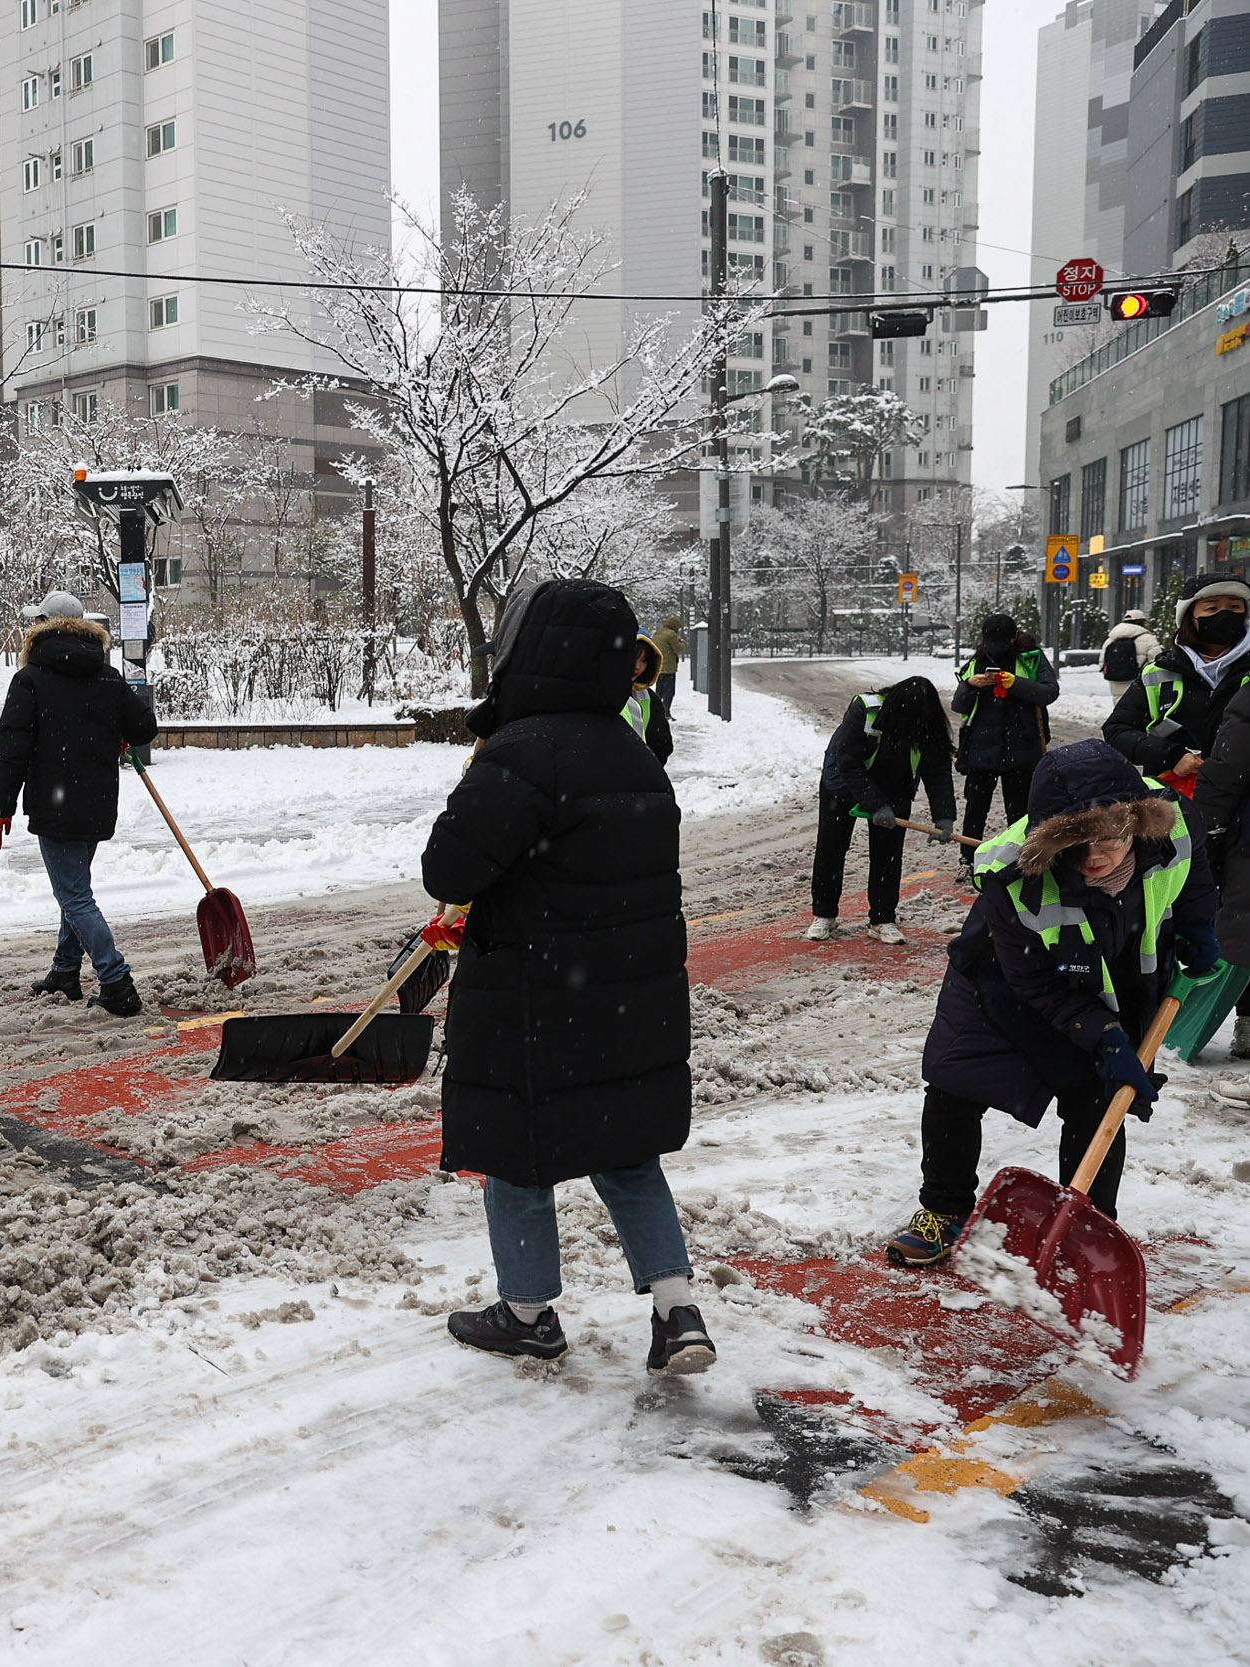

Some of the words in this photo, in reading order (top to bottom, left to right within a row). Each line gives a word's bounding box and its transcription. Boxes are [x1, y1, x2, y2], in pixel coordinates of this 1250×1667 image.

[548, 119, 587, 142] 106
[1063, 264, 1097, 281] 정지
[1063, 283, 1096, 296] STOP
[1057, 306, 1098, 323] 어린이보호구역
[1043, 331, 1064, 344] 110
